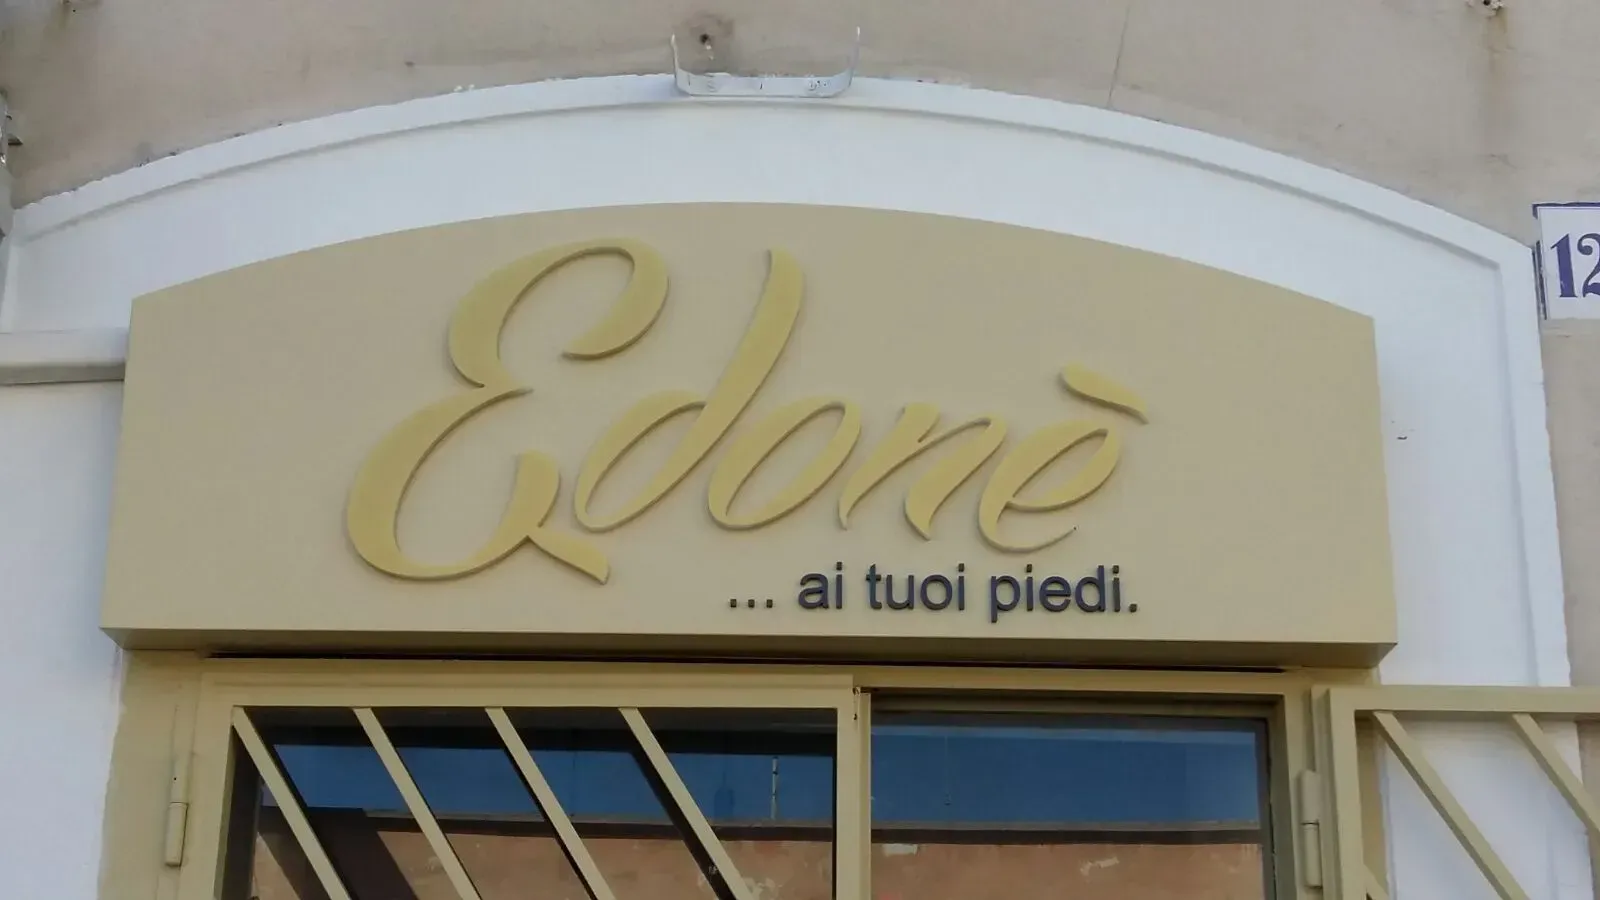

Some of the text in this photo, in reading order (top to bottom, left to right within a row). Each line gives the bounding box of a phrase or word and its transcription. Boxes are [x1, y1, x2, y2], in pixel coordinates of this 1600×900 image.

[345, 236, 1149, 585] Edonè
[797, 561, 844, 610] ai
[865, 563, 966, 611] tuoi
[990, 564, 1139, 623] piedi.
